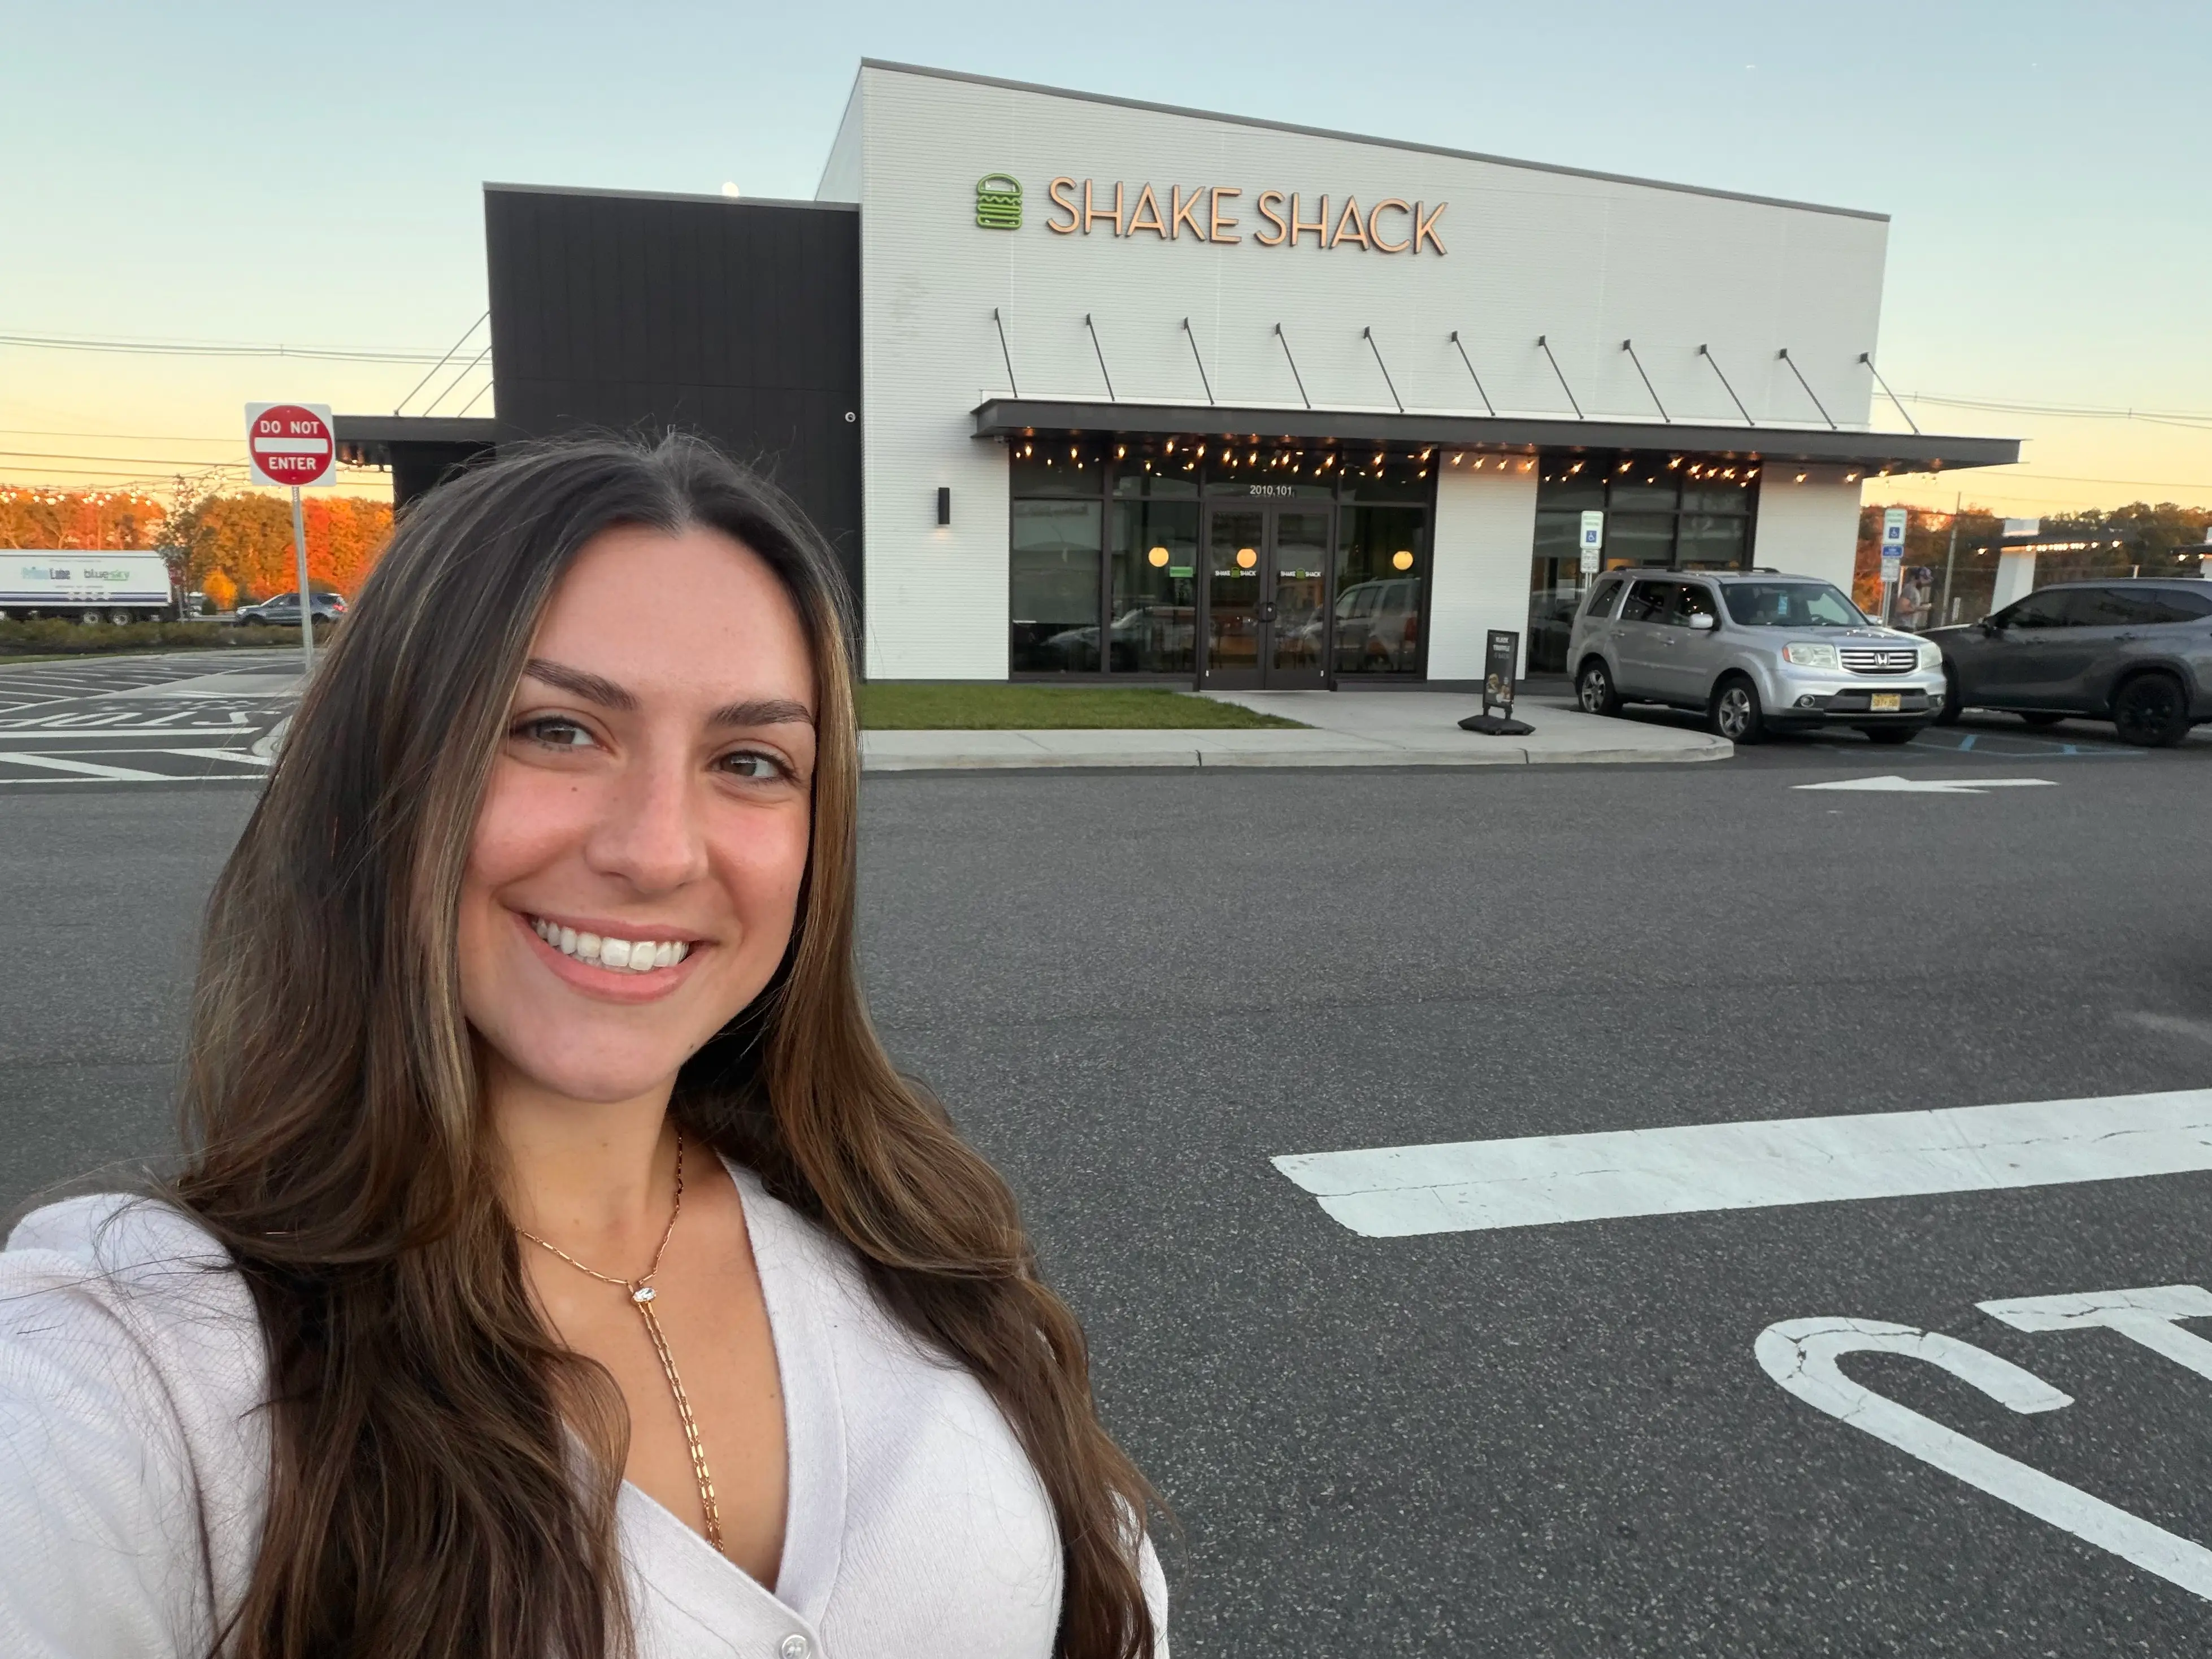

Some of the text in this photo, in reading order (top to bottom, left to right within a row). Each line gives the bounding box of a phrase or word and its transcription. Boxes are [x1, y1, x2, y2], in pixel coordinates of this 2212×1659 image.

[1046, 176, 1449, 257] SHAKE SHACK
[260, 420, 319, 434] DO NOT
[268, 457, 316, 470] ENTER
